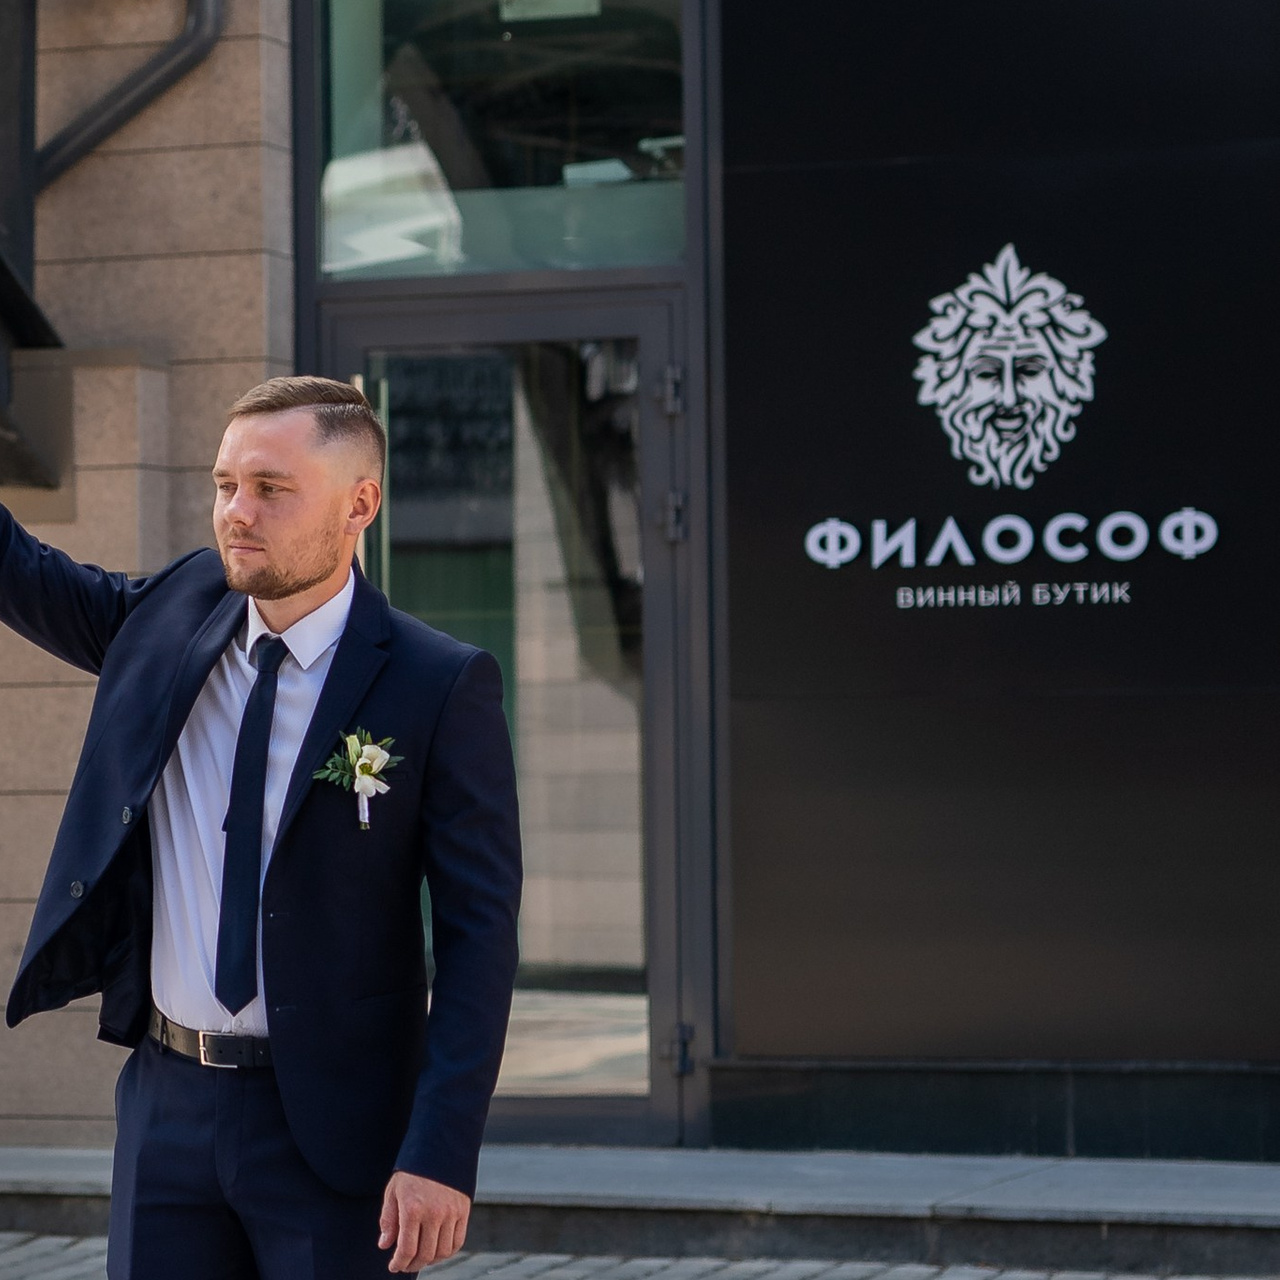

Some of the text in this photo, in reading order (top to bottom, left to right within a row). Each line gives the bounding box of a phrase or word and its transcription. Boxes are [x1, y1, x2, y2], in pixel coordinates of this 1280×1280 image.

[803, 506, 1219, 571] ФИЛОСОФ
[895, 580, 1131, 609] ВИННЫЙ БУТИК
